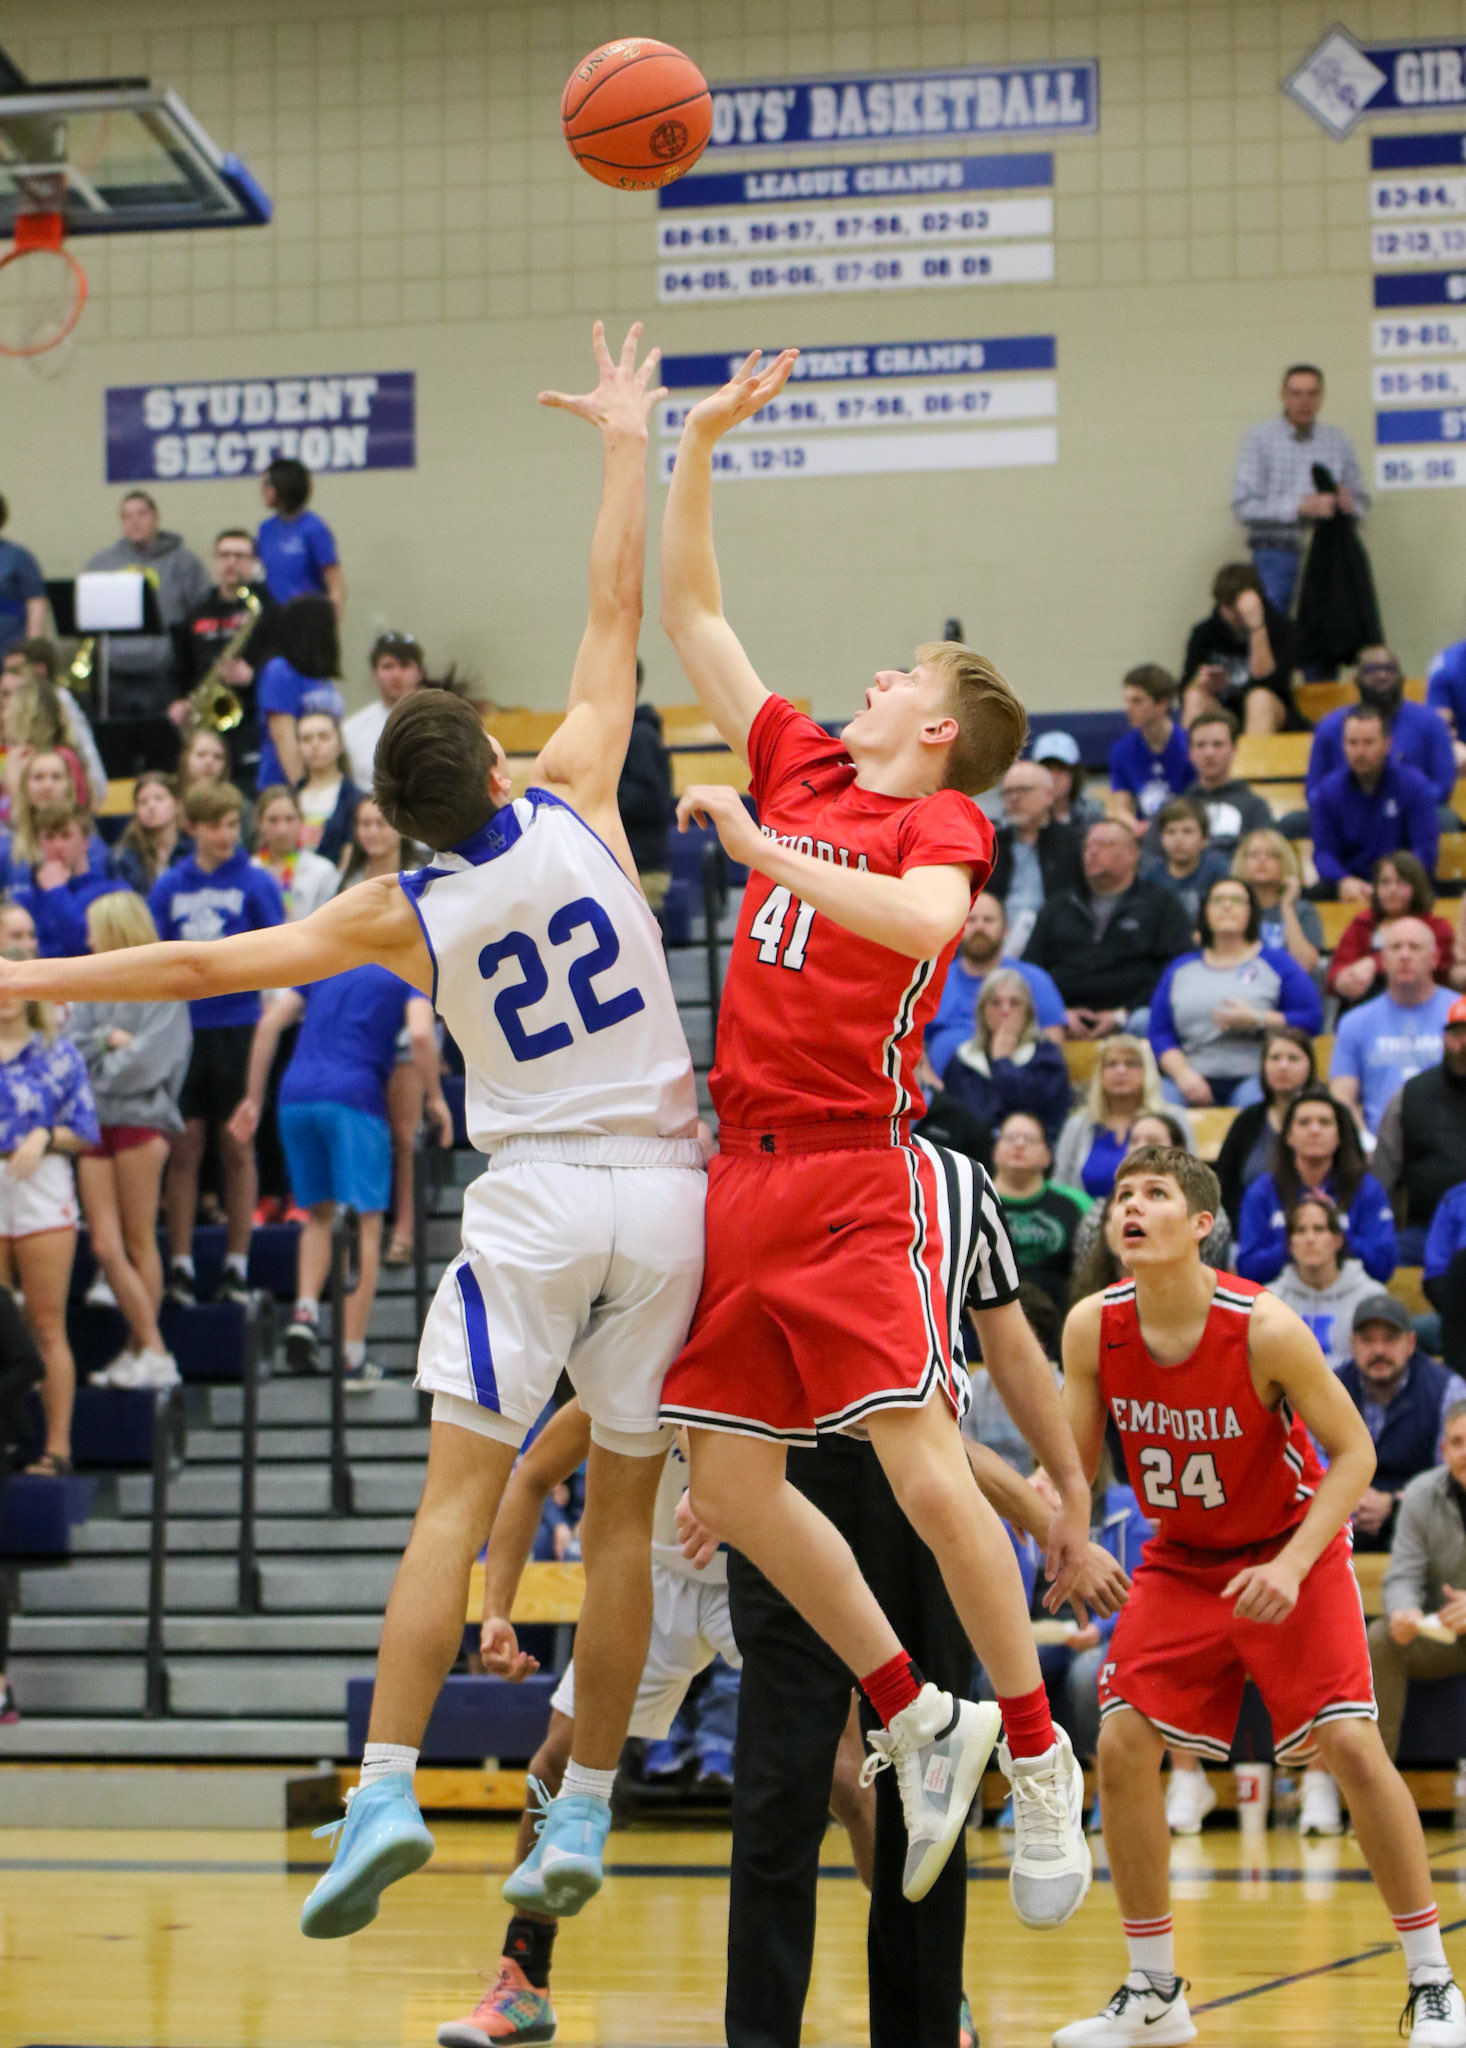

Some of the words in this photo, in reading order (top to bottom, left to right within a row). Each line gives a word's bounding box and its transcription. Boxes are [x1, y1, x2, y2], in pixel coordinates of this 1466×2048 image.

[712, 89, 796, 144] OYS'
[811, 73, 1084, 138] BASKETBALL
[745, 169, 849, 199] LEAGUE
[855, 163, 964, 192] CHAMPS
[922, 210, 989, 232] 02-03
[874, 343, 985, 373] CHAMPS
[144, 377, 379, 430] STUDENT
[154, 424, 369, 478] SECTION
[749, 884, 817, 972] 41
[478, 896, 645, 1063] 22
[1111, 1397, 1244, 1441] EMPORIA
[1139, 1446, 1228, 1510] 24
